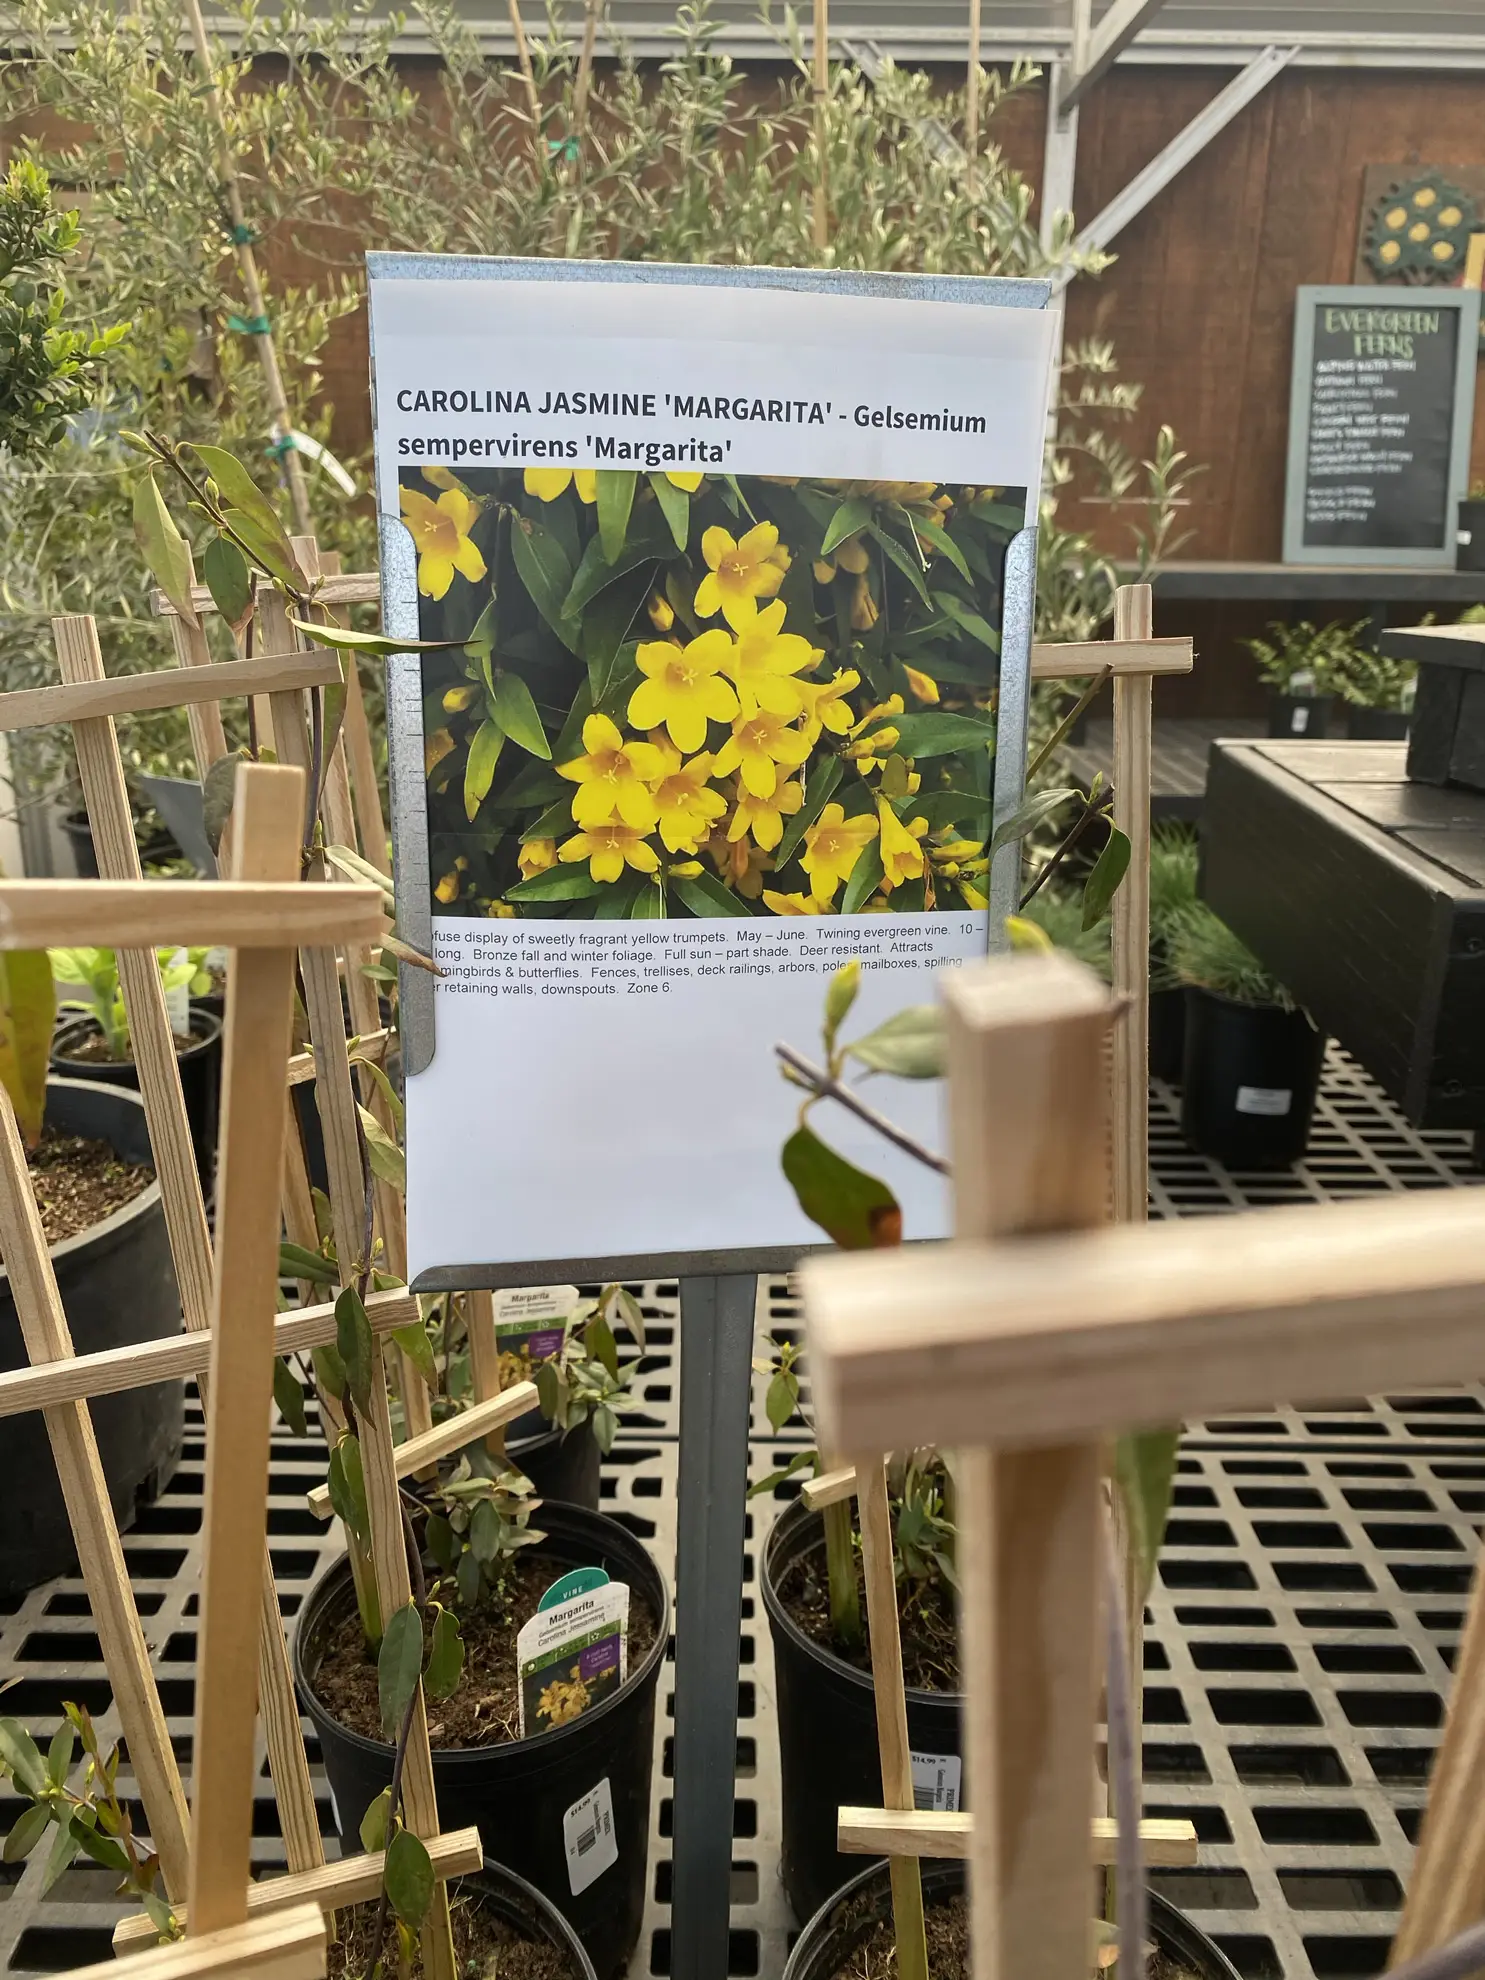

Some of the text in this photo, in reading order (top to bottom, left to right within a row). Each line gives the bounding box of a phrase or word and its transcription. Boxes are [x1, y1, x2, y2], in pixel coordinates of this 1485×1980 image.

[1325, 308, 1439, 334] EVERGREEN
[1354, 334, 1414, 359] FERNS
[396, 389, 532, 414] CAROLINA
[537, 391, 657, 418] JASMINE
[664, 393, 832, 425] 'MARGARITA'
[853, 404, 987, 434] Gelsemium
[397, 433, 732, 467] sempervirens 'Margarita'
[464, 931, 509, 947] display
[512, 932, 526, 945] of
[528, 933, 576, 948] sweetly
[578, 933, 628, 948] fragrant
[631, 932, 670, 947] yellow
[672, 931, 729, 946] trumpets.
[736, 929, 763, 944] May
[776, 929, 808, 941] June.
[815, 928, 861, 941] Twining
[863, 927, 922, 940] evergreen
[924, 924, 951, 936] vine.
[959, 923, 973, 935] 10
[434, 947, 465, 962] long.
[473, 948, 518, 961] Bronze
[521, 949, 540, 962] fall
[543, 950, 568, 962] and
[570, 950, 610, 963] winter
[612, 949, 656, 964] foliage.
[664, 948, 687, 960] Full
[689, 949, 712, 960] sun
[726, 946, 750, 960] part
[752, 944, 792, 958] shade.
[799, 944, 829, 957] Deer
[831, 942, 883, 956] resistant.
[889, 940, 934, 954] Attracts
[504, 966, 516, 978] &
[518, 966, 583, 979] butterflies.
[591, 965, 641, 980] Fences,
[643, 963, 694, 978] trellises,
[697, 961, 726, 976] deck
[729, 961, 775, 976] railings,
[778, 959, 819, 974] arbors,
[822, 959, 855, 974] pole
[860, 956, 921, 970] mailboxes,
[924, 954, 963, 969] spilling
[444, 982, 499, 997] retaining
[501, 983, 537, 997] walls,
[541, 983, 620, 998] downspouts.
[626, 982, 659, 994] Zone
[661, 981, 673, 993] 6.
[511, 1292, 550, 1303] Margarita
[562, 1586, 583, 1599] VINE
[549, 1600, 595, 1625] Margarita
[538, 1630, 567, 1647] Carolina
